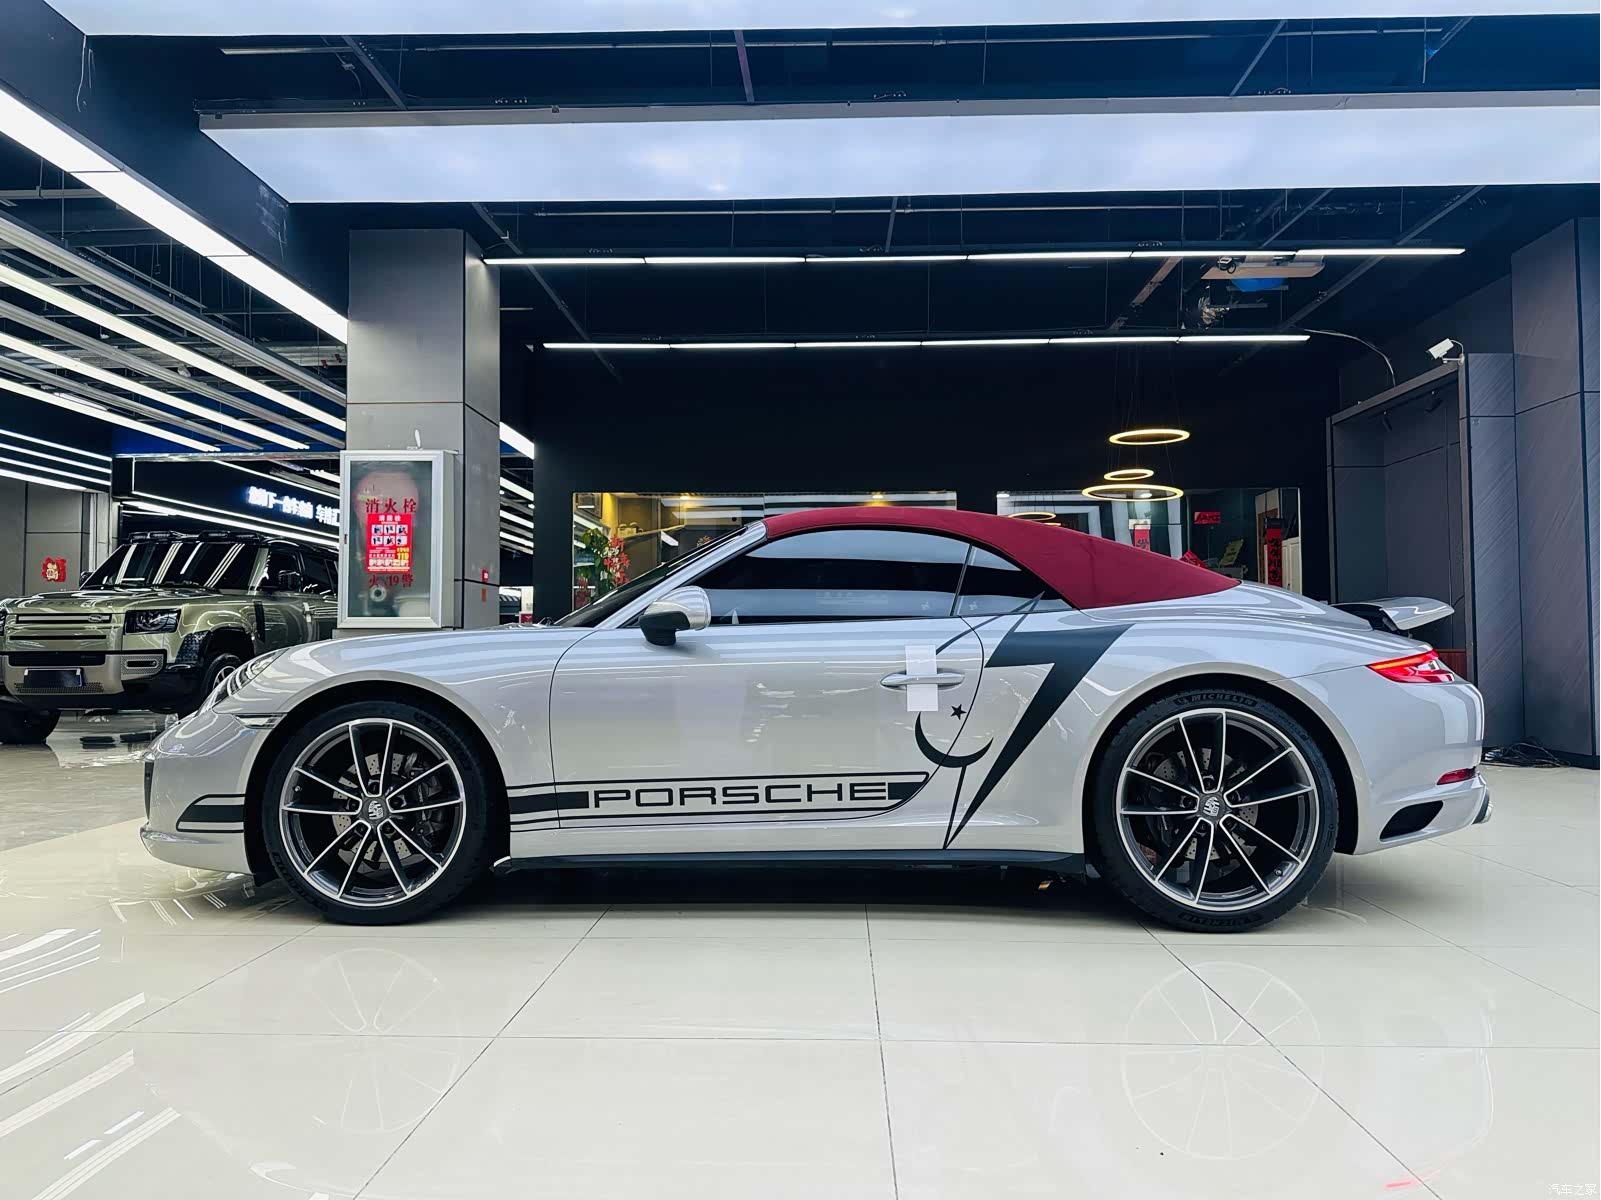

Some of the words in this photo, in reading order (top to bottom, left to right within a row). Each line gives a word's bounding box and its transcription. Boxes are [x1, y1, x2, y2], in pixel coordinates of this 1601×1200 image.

[365, 497, 416, 514] 消火栓
[1191, 693, 1254, 706] MICHELIN
[593, 782, 887, 809] PORSCHE
